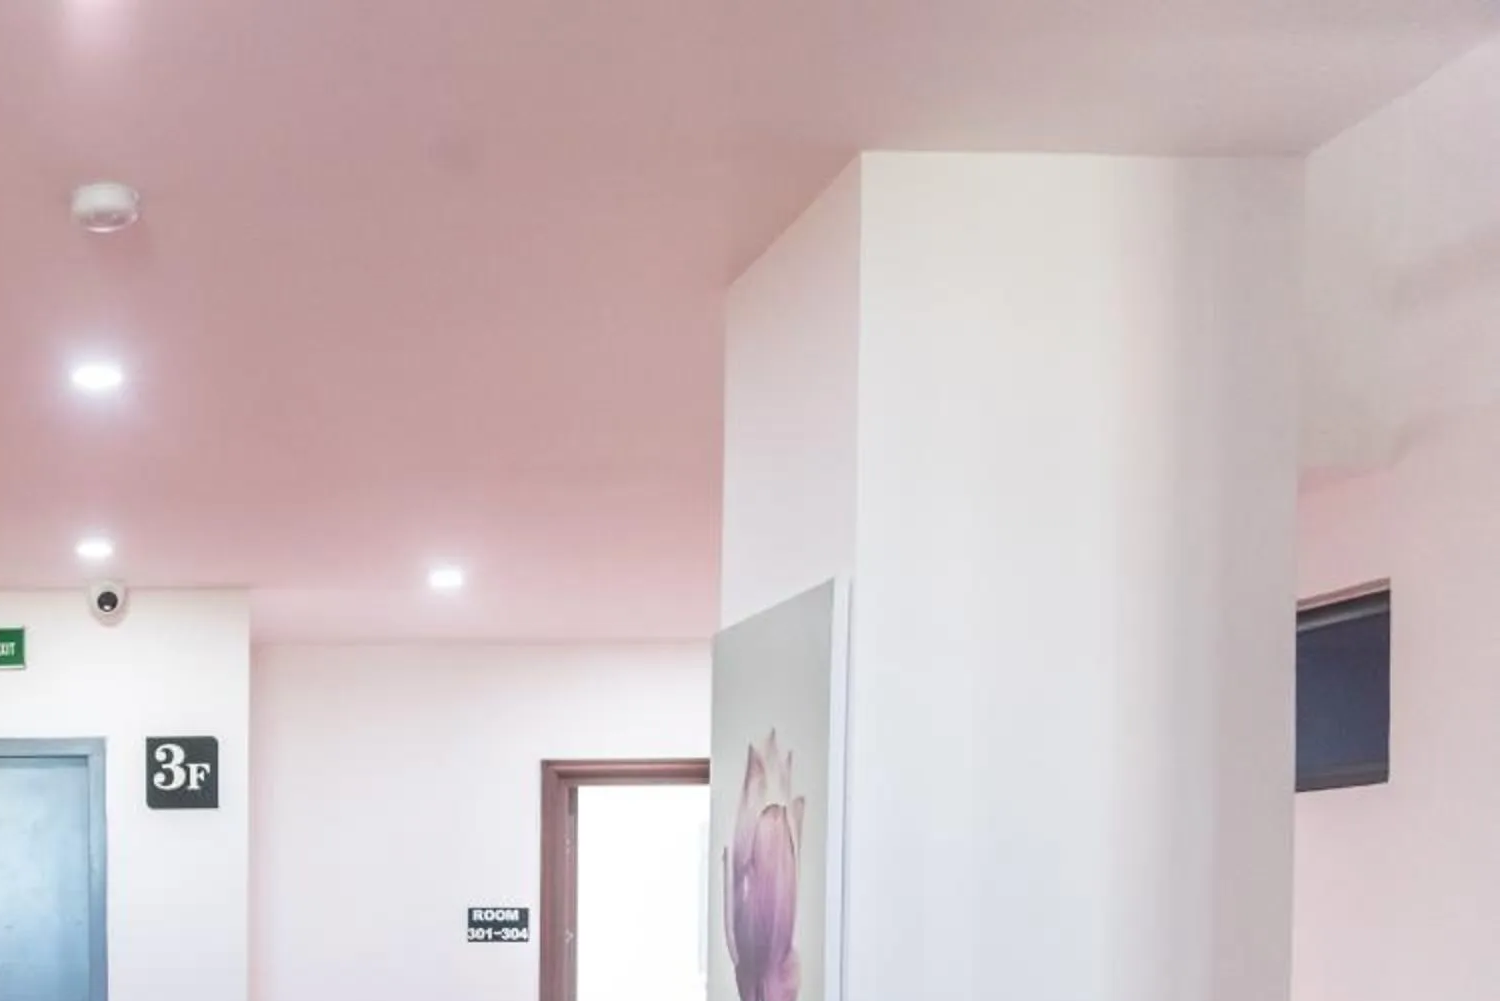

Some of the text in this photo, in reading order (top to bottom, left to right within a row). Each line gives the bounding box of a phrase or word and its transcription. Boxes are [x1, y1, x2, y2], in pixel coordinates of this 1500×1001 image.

[153, 743, 211, 790] 3F
[472, 909, 519, 921] ROOM
[467, 927, 527, 940] 301-304
